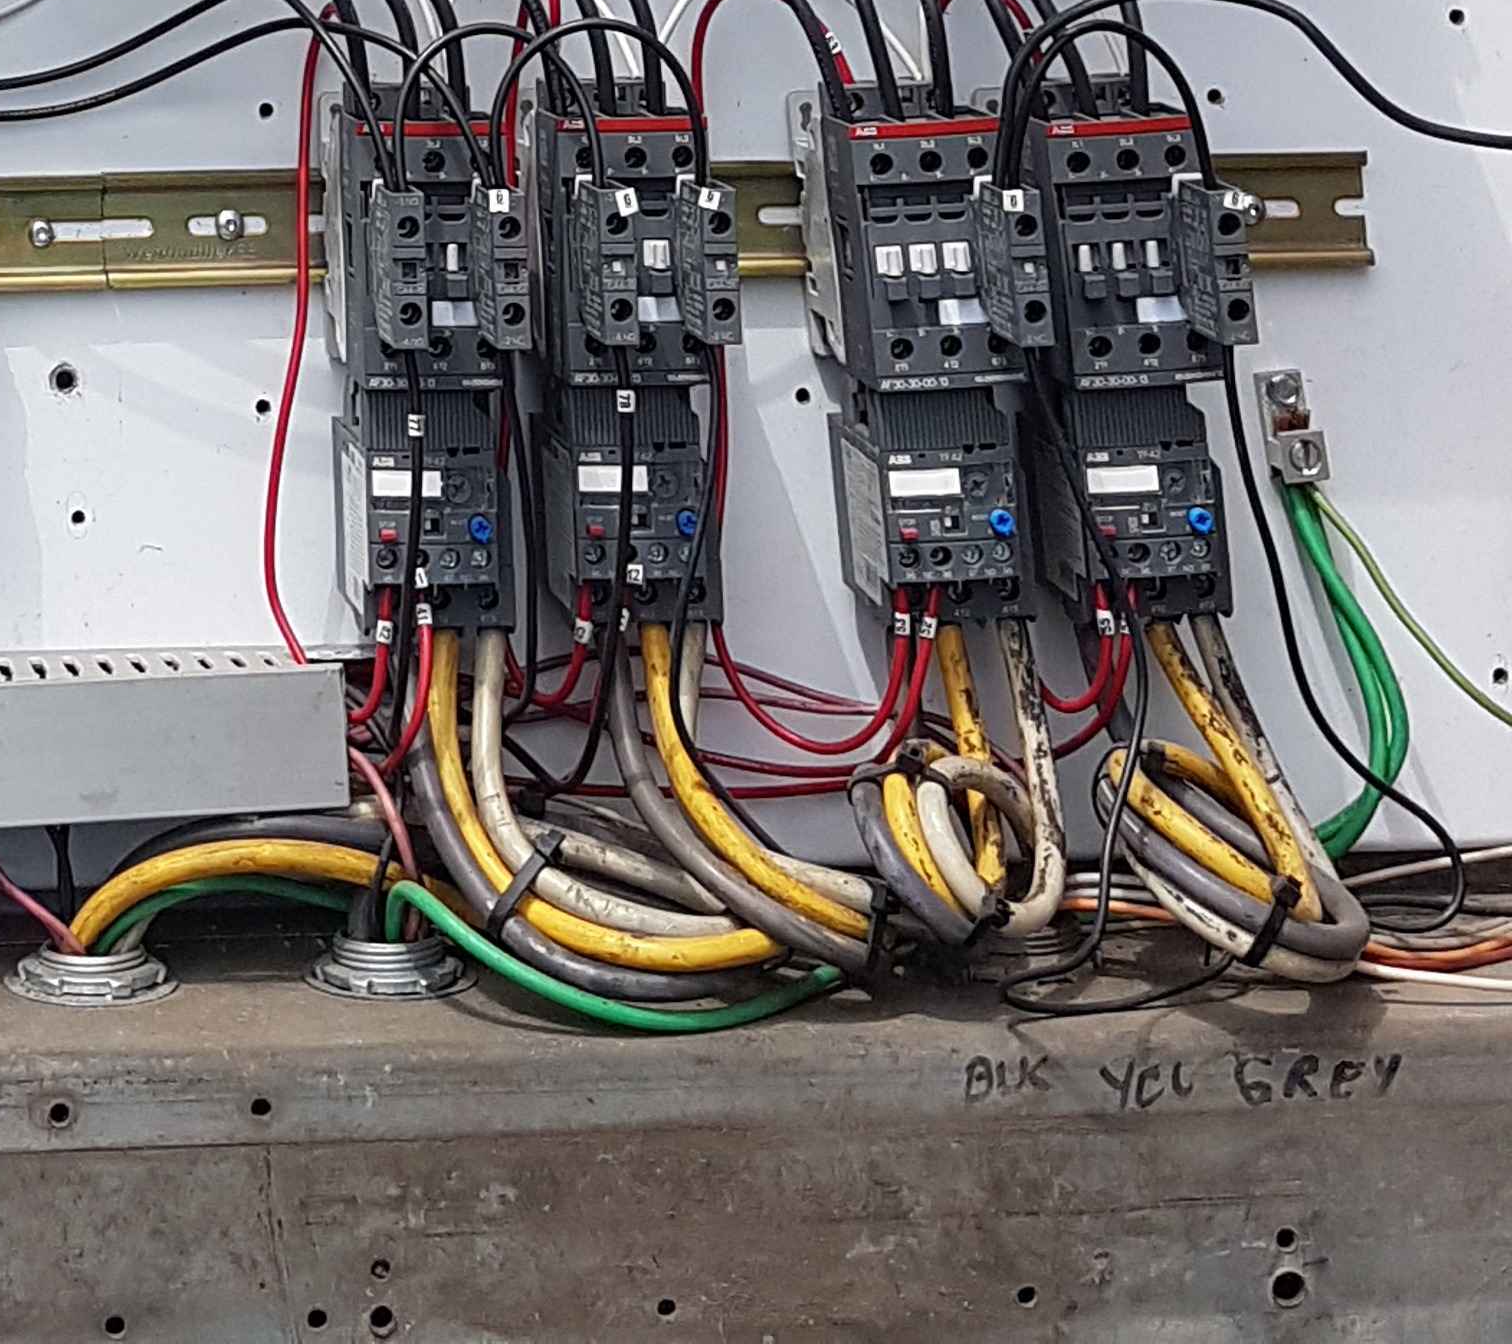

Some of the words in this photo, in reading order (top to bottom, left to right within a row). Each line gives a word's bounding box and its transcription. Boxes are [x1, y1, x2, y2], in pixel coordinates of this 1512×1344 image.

[618, 394, 631, 409] 78
[409, 419, 423, 432] 77
[888, 455, 912, 464] ABB
[964, 1055, 1051, 1103] BLK
[1225, 1050, 1403, 1106] GREY
